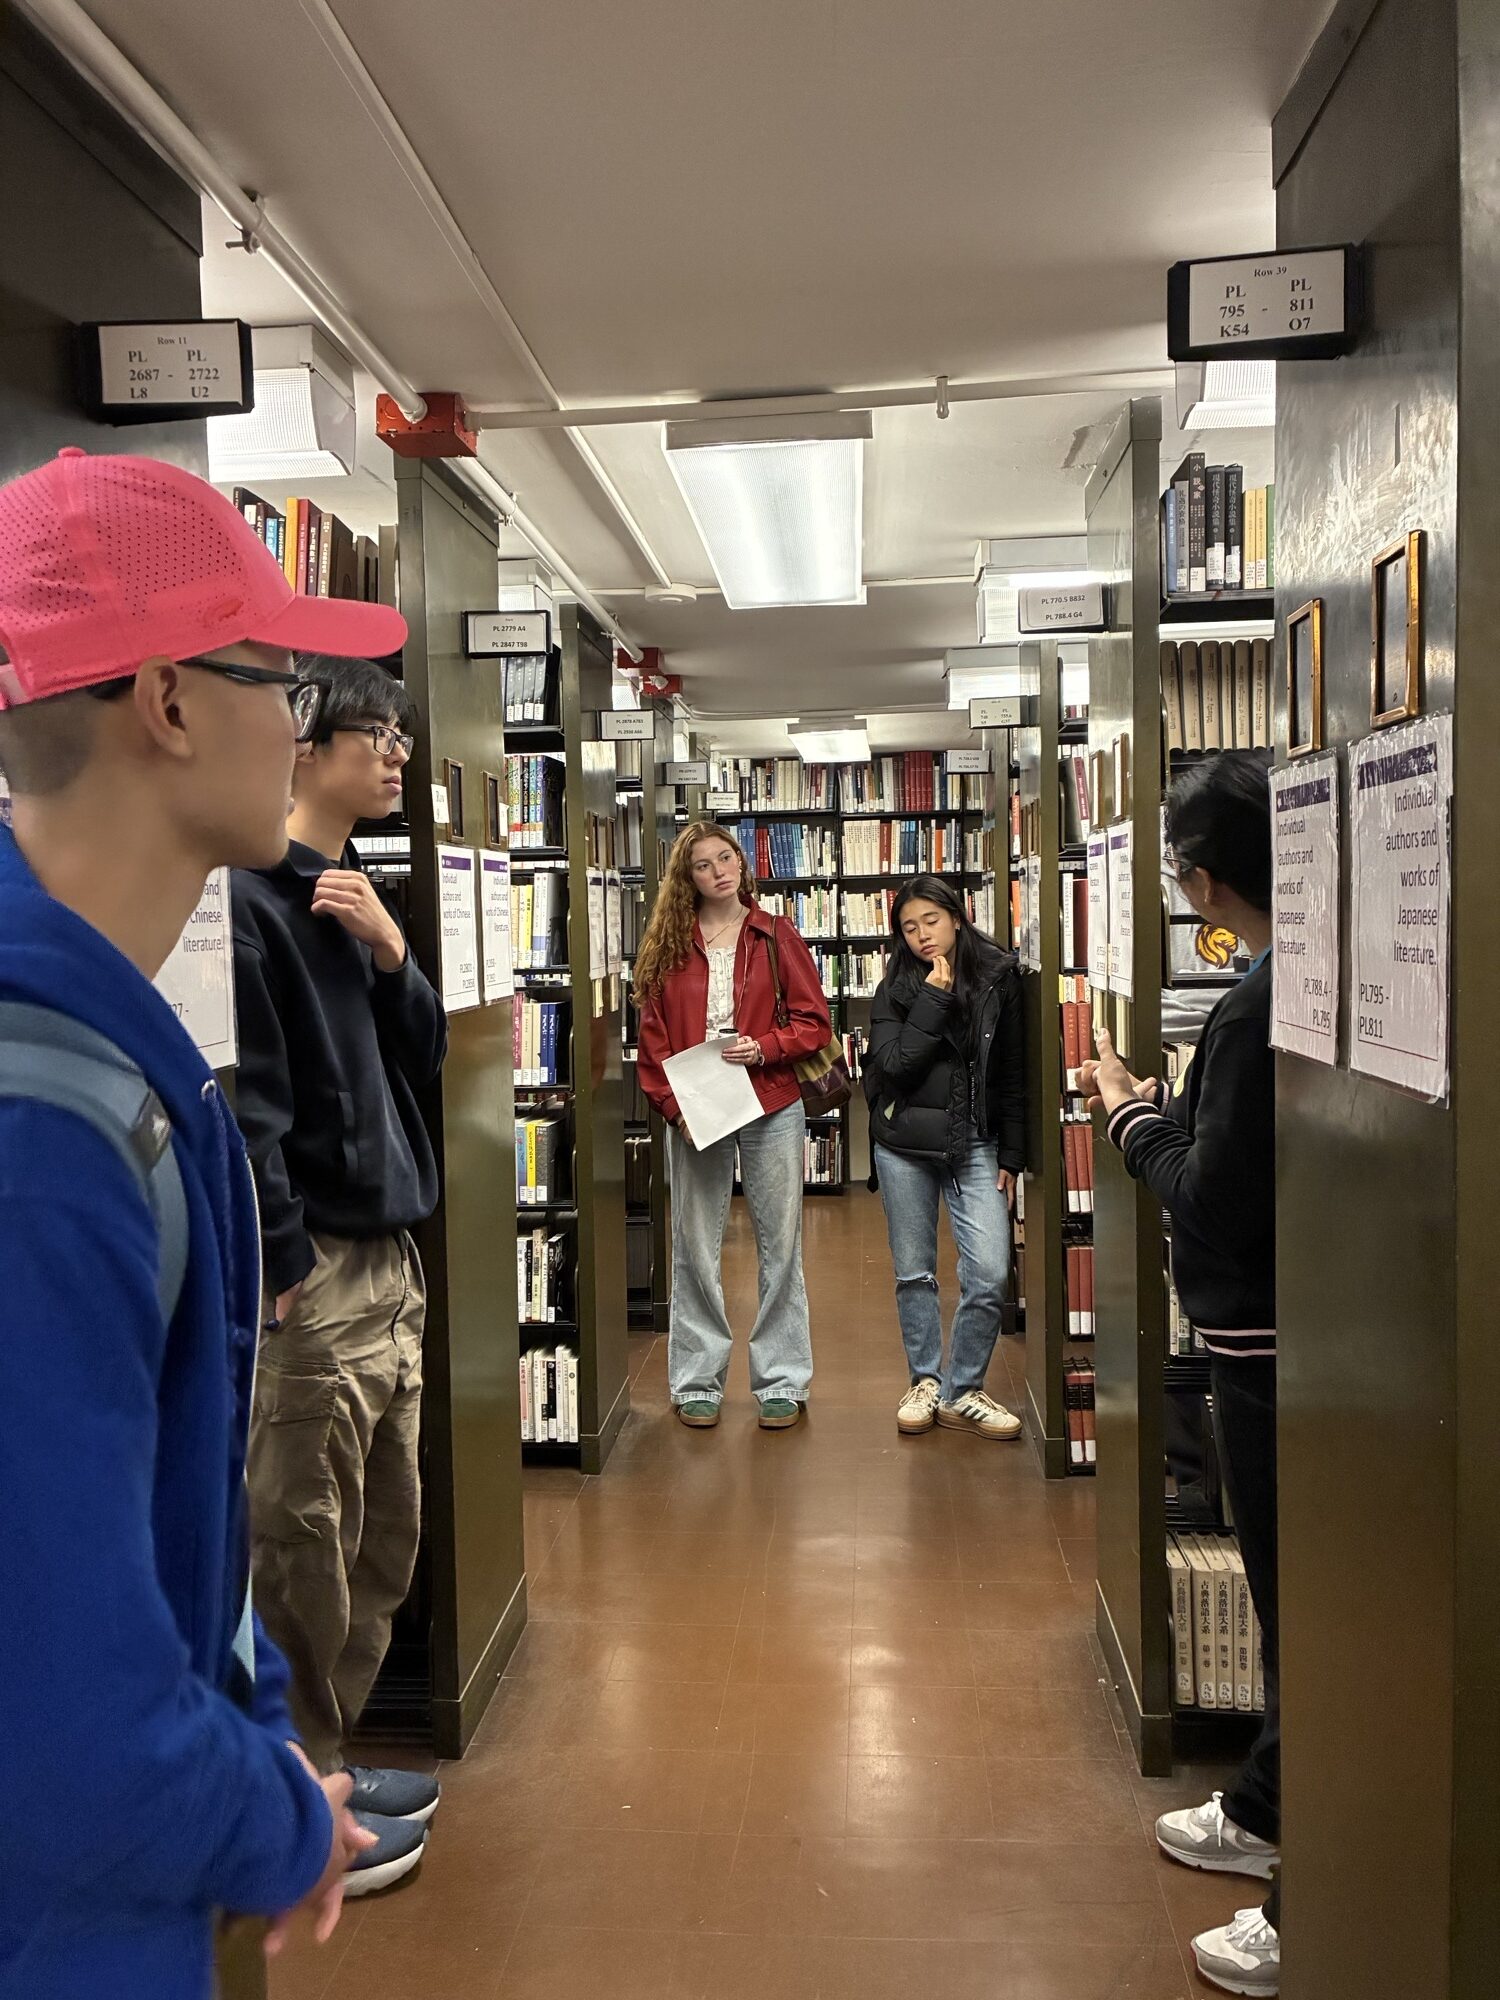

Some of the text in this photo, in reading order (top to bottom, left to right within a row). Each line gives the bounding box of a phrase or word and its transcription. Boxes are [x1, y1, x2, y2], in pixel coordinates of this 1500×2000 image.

[1254, 267, 1287, 277] Row 39
[1225, 279, 1312, 298] PL PL
[1219, 305, 1245, 319] 795
[1289, 298, 1314, 312] 811
[1219, 317, 1311, 338] K54 O7
[157, 337, 187, 345] Row 11
[128, 350, 207, 362] PL PL
[129, 369, 160, 381] 2687
[188, 368, 220, 380] 2722
[130, 386, 209, 399] L8 U2
[1050, 596, 1068, 604] 770.5
[1054, 612, 1072, 620] 788.4
[1394, 782, 1437, 812] Individual
[1277, 819, 1306, 837] Individual
[1386, 823, 1437, 851] authors and
[1278, 845, 1314, 866] authors and
[1401, 862, 1439, 887] works of
[204, 880, 220, 895] and
[1278, 876, 1304, 896] works of
[1277, 908, 1305, 930] Japanese
[1398, 904, 1437, 931] Japanese
[1393, 940, 1437, 966] literature.
[1360, 983, 1384, 1005] PL795
[1312, 1008, 1331, 1029] PL795
[1359, 1016, 1383, 1039] PL811
